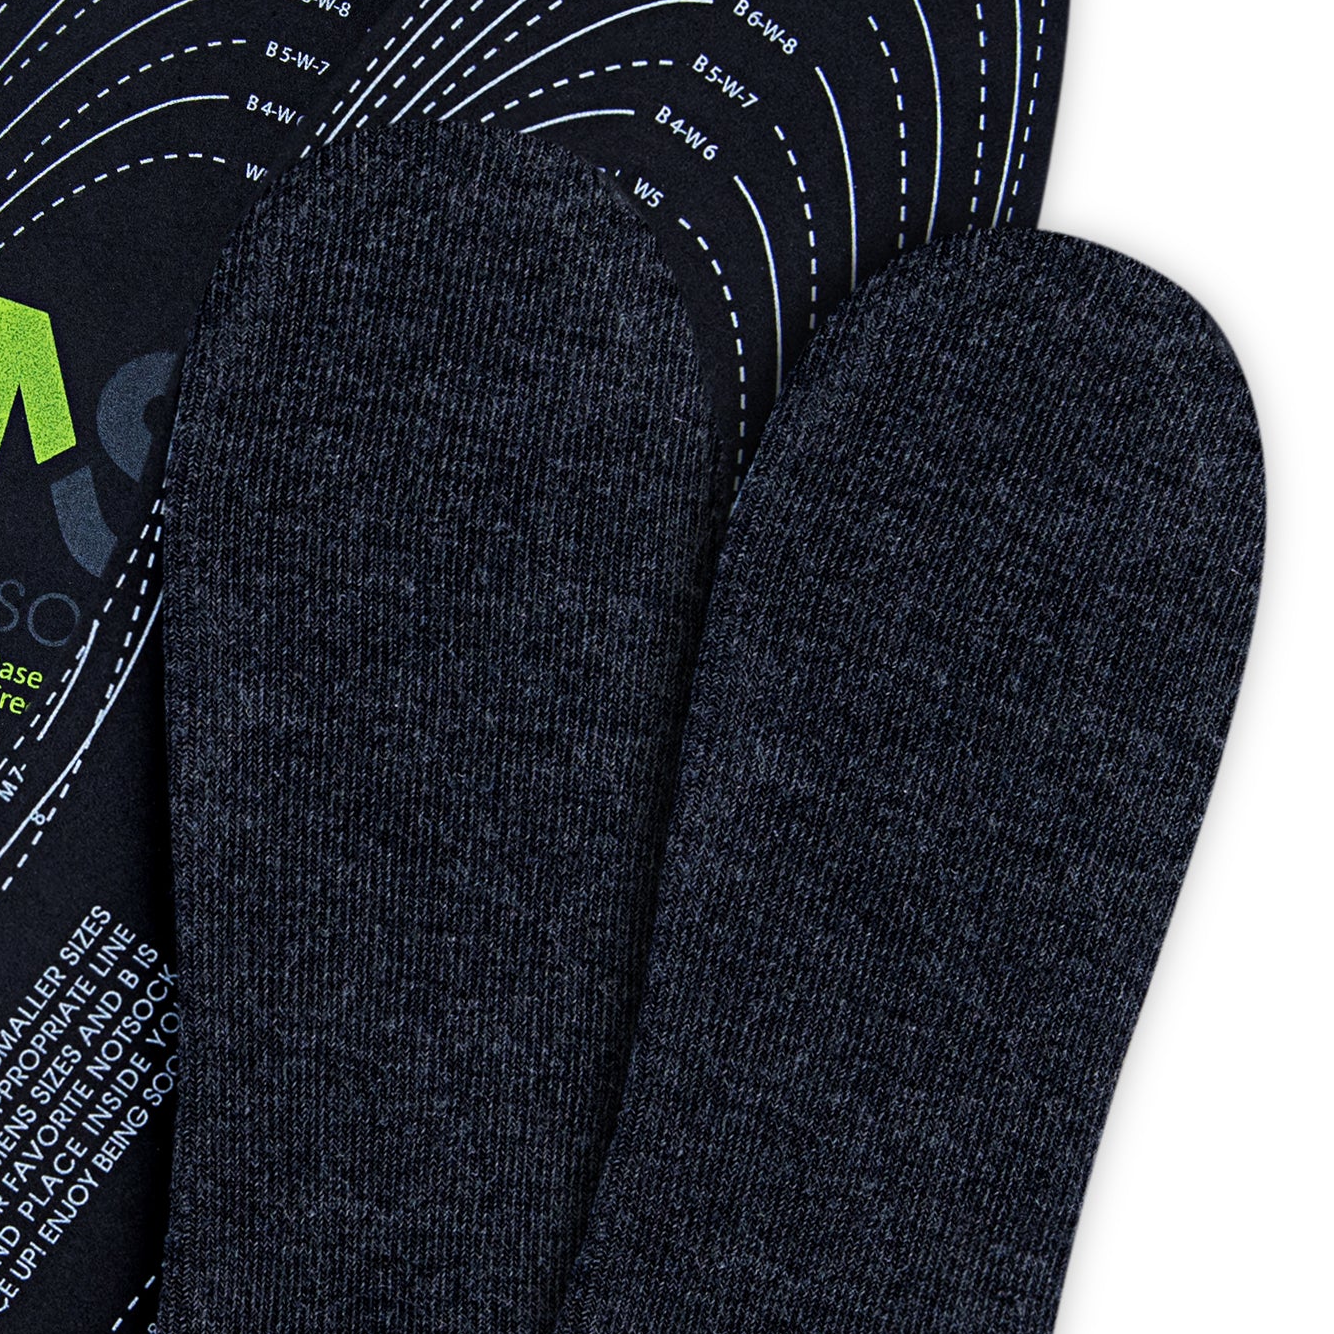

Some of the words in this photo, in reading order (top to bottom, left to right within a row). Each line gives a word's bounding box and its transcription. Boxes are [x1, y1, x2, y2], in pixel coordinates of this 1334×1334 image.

[59, 905, 111, 966] SIZES
[88, 923, 136, 978] LINE
[30, 1044, 82, 1105] SIZES
[78, 990, 122, 1047] AND
[117, 968, 140, 990] B
[132, 943, 158, 969] IS
[1, 1078, 95, 1193] FAVORITE
[17, 1136, 89, 1222] PLACE
[81, 1052, 152, 1136] INSIDE
[144, 1000, 184, 1049] YO
[9, 1241, 47, 1280] UP!
[37, 1168, 99, 1245] ENJOY
[91, 1105, 149, 1173] BEING
